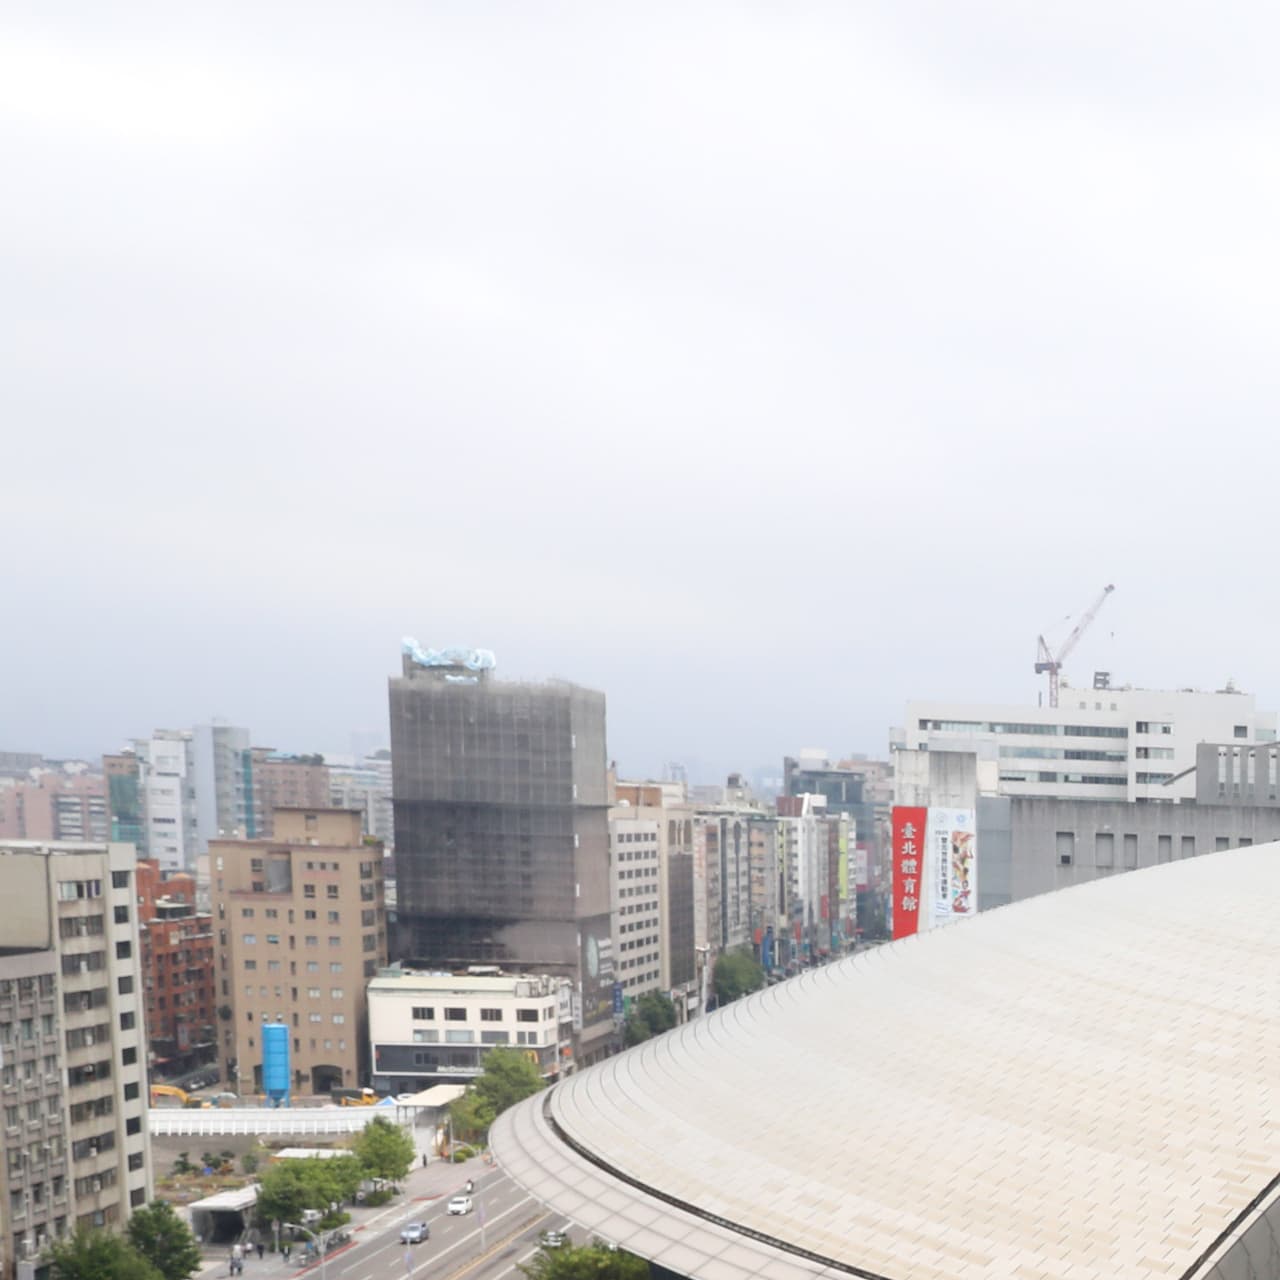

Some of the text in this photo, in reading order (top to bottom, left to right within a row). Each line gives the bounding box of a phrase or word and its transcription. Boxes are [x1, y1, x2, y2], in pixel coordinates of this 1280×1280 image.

[901, 822, 918, 912] 臺北體育館
